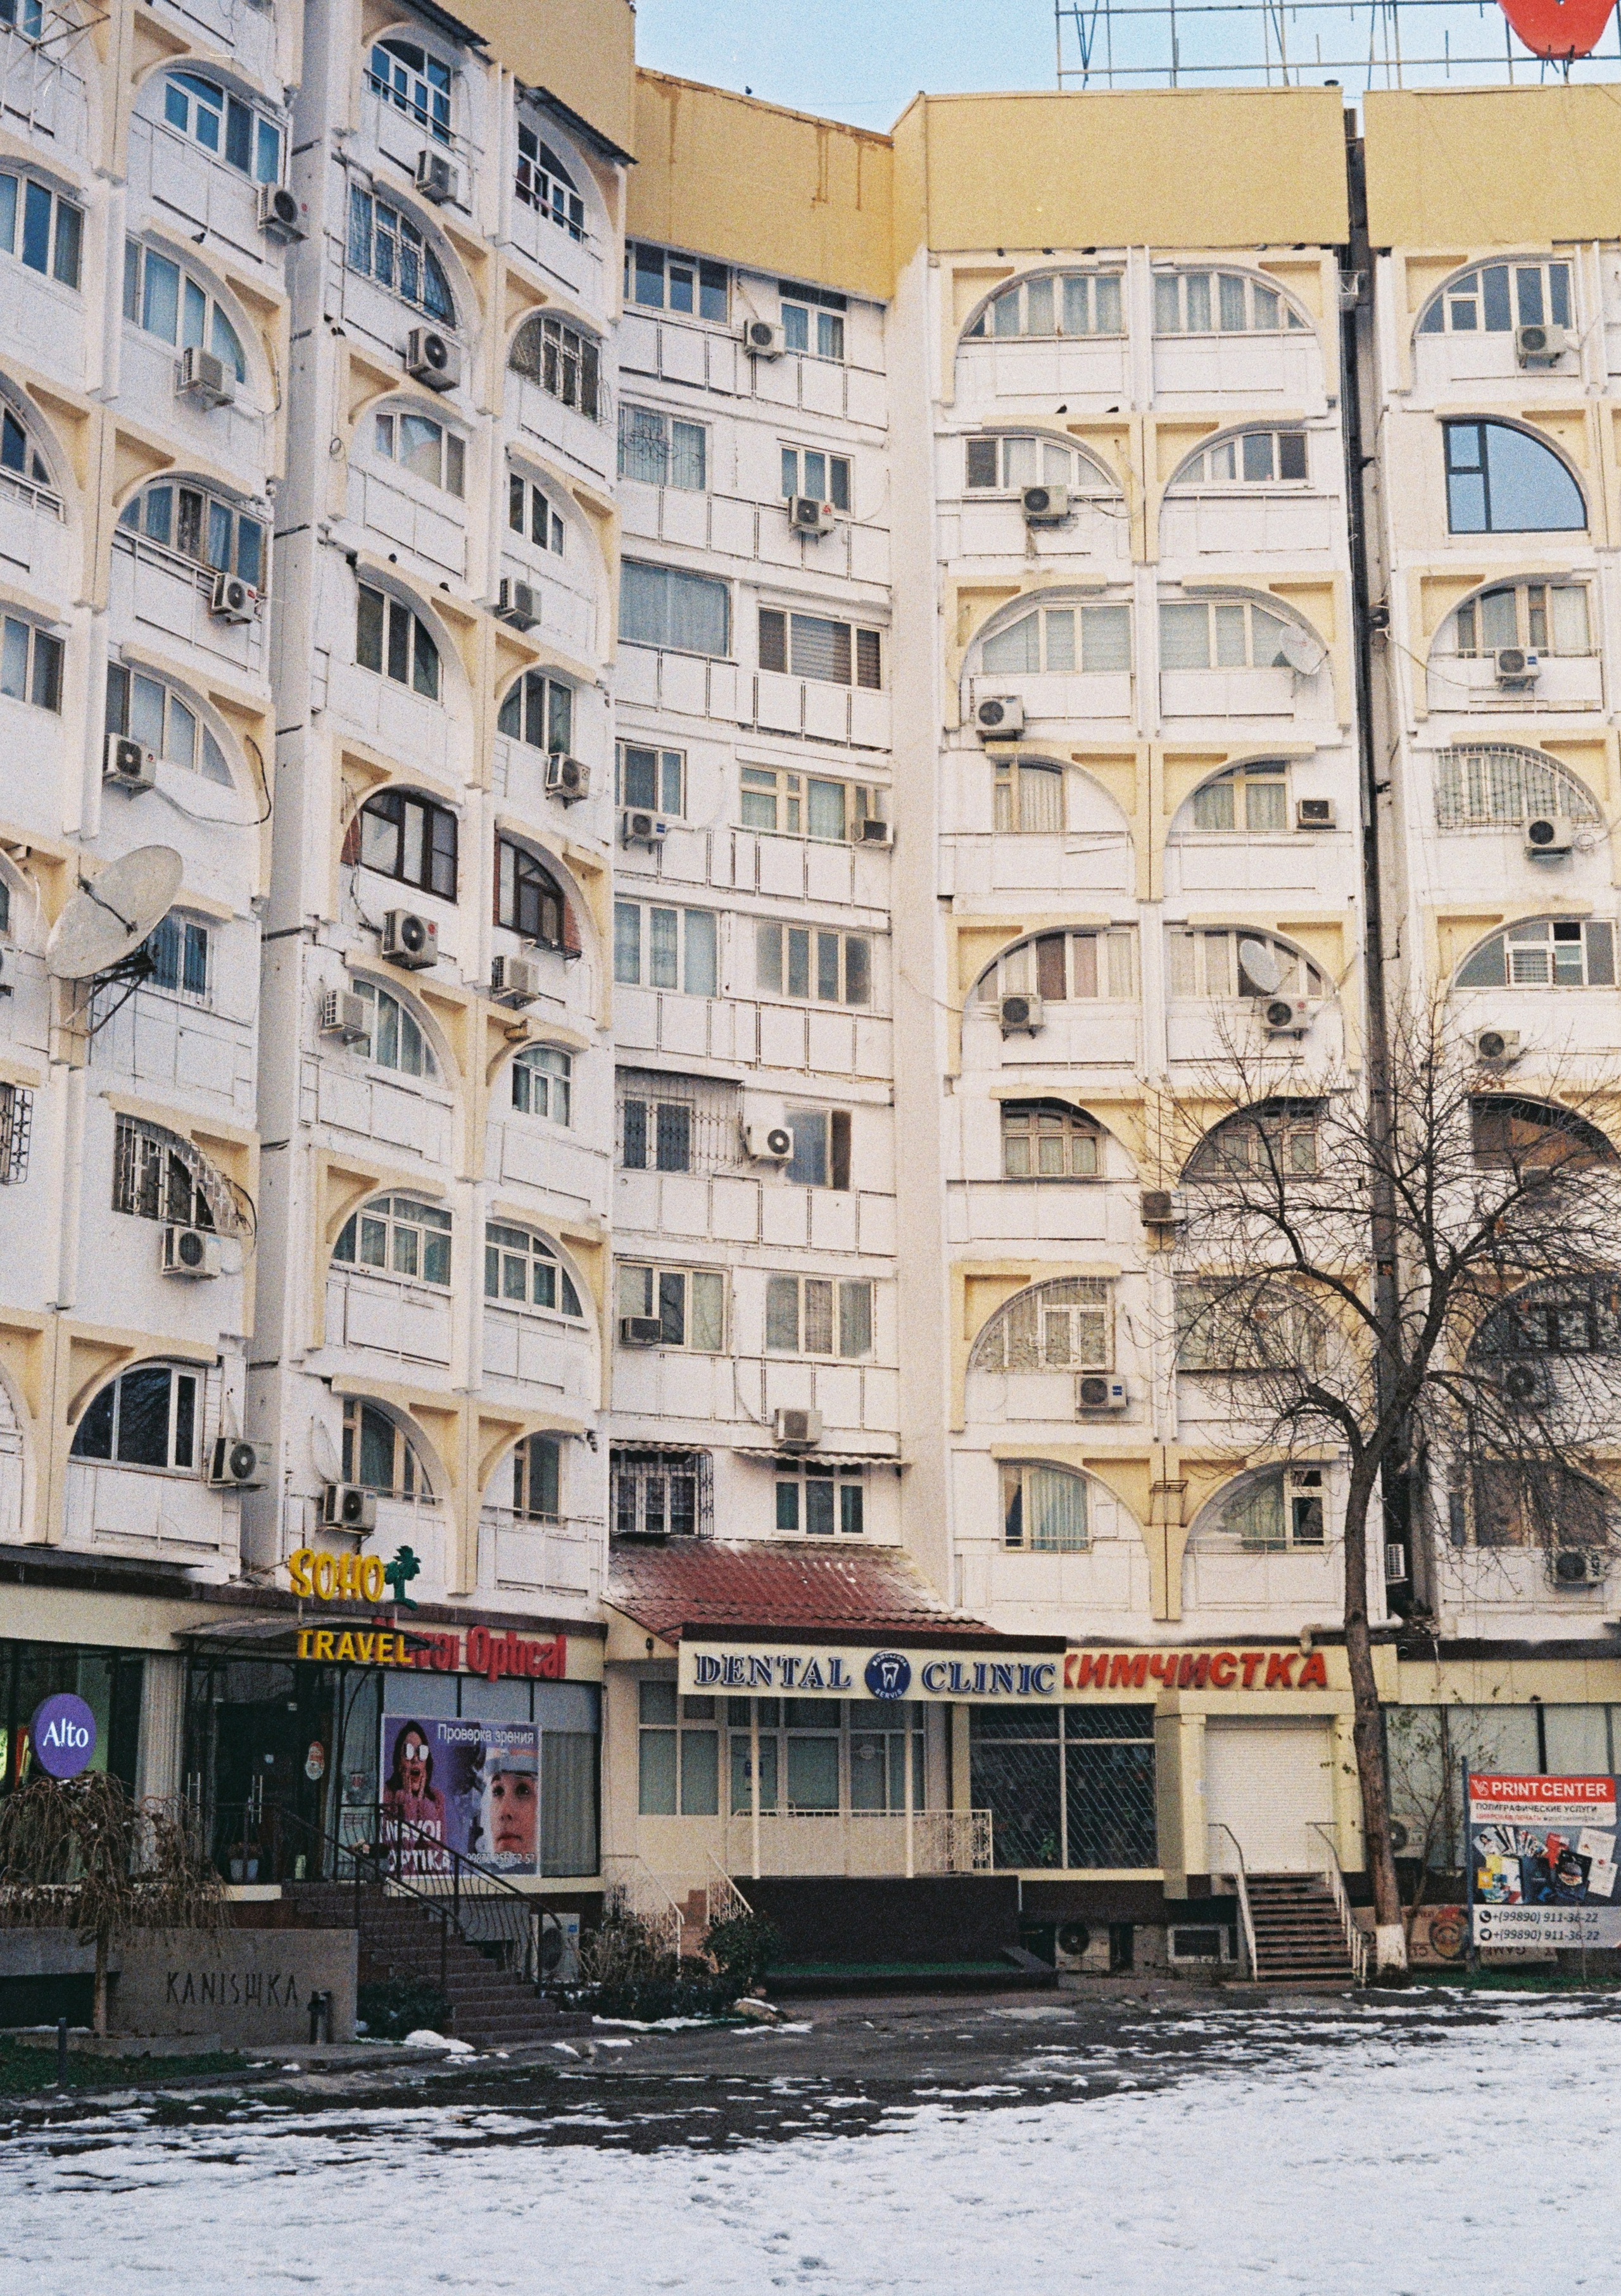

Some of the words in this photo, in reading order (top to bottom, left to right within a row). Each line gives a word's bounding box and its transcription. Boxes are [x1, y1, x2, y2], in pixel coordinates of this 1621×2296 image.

[289, 1548, 385, 1602] SOHO
[297, 1629, 412, 1663] TRAVEL
[466, 1625, 567, 1683] Optical
[694, 1652, 852, 1688] DENTAL
[921, 1660, 1056, 1693] CLINIC
[875, 1688, 903, 1699] SERVIS
[42, 1717, 89, 1748] Alto
[438, 1723, 492, 1745] Проверка
[495, 1729, 534, 1746] зрения
[1492, 1782, 1539, 1797] PRINT
[1541, 1783, 1608, 1797] CENTER
[1476, 1803, 1561, 1813] ПОЛИГРАФИЧЕСКИЕ
[1563, 1805, 1597, 1813] УСЛУГИ
[1493, 1910, 1541, 1924] +(99890)
[1543, 1912, 1598, 1923] 911-36-22
[1494, 1929, 1541, 1942] +(99890)
[1544, 1930, 1599, 1941] 911-36-22
[167, 1971, 298, 2007] KANISHKA
